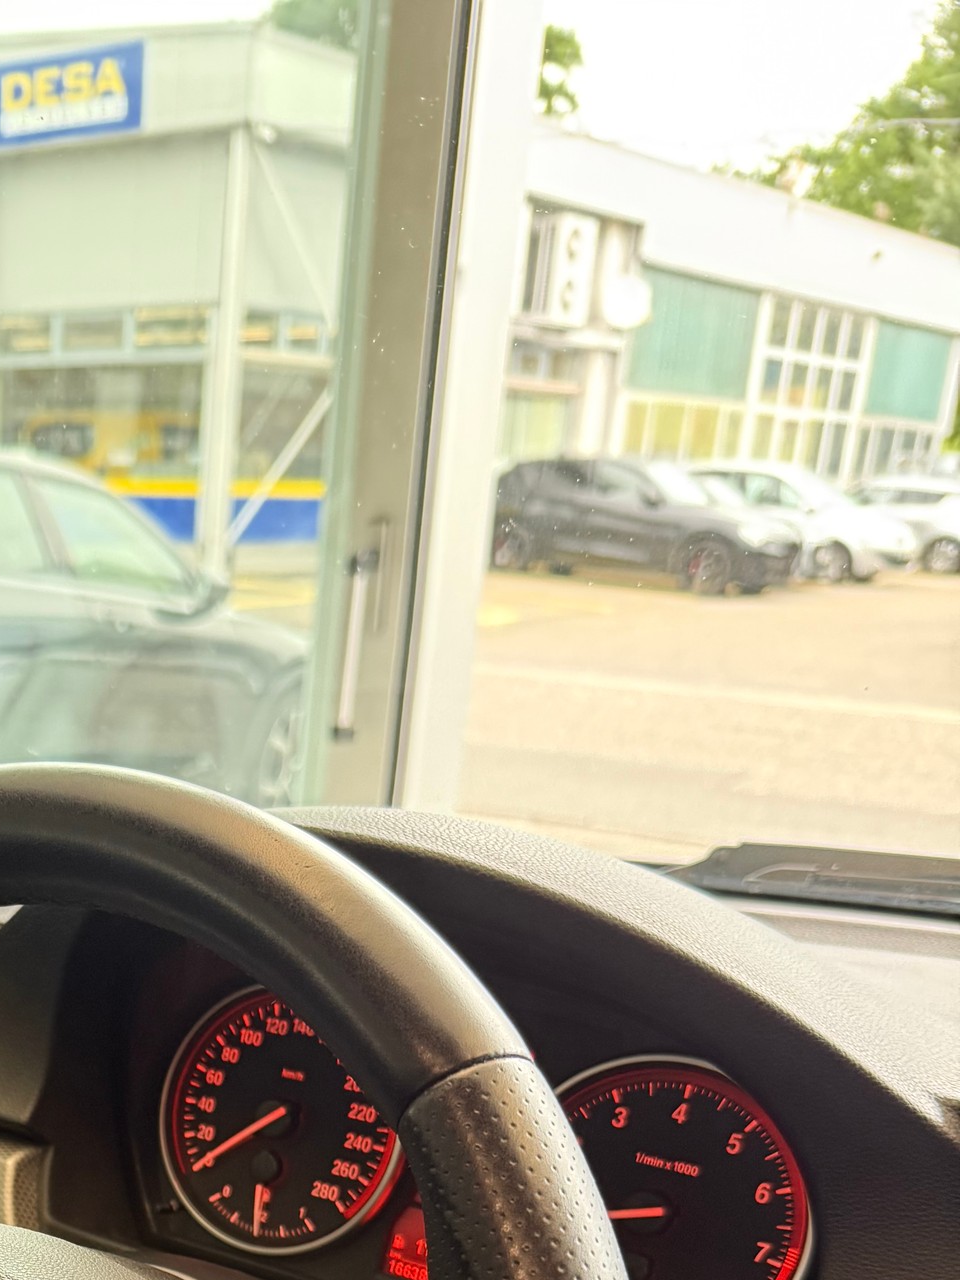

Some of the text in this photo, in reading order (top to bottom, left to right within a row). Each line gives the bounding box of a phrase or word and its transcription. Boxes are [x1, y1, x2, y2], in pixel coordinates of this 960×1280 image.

[0, 57, 126, 112] DESA
[266, 1017, 288, 1036] 120
[240, 1029, 262, 1047] 100
[222, 1046, 239, 1063] 80
[205, 1070, 223, 1086] 60
[198, 1096, 215, 1113] 40
[348, 1103, 377, 1123] 220
[671, 1103, 688, 1125] 4
[611, 1106, 629, 1129] 3
[197, 1124, 215, 1141] 20
[343, 1133, 372, 1153] 240
[726, 1133, 743, 1154] 5
[331, 1159, 359, 1180] 260
[635, 1151, 664, 1169] 1/min
[673, 1161, 699, 1178] 1000
[311, 1182, 339, 1202] 280
[754, 1182, 771, 1204] 6
[754, 1241, 771, 1263] 7
